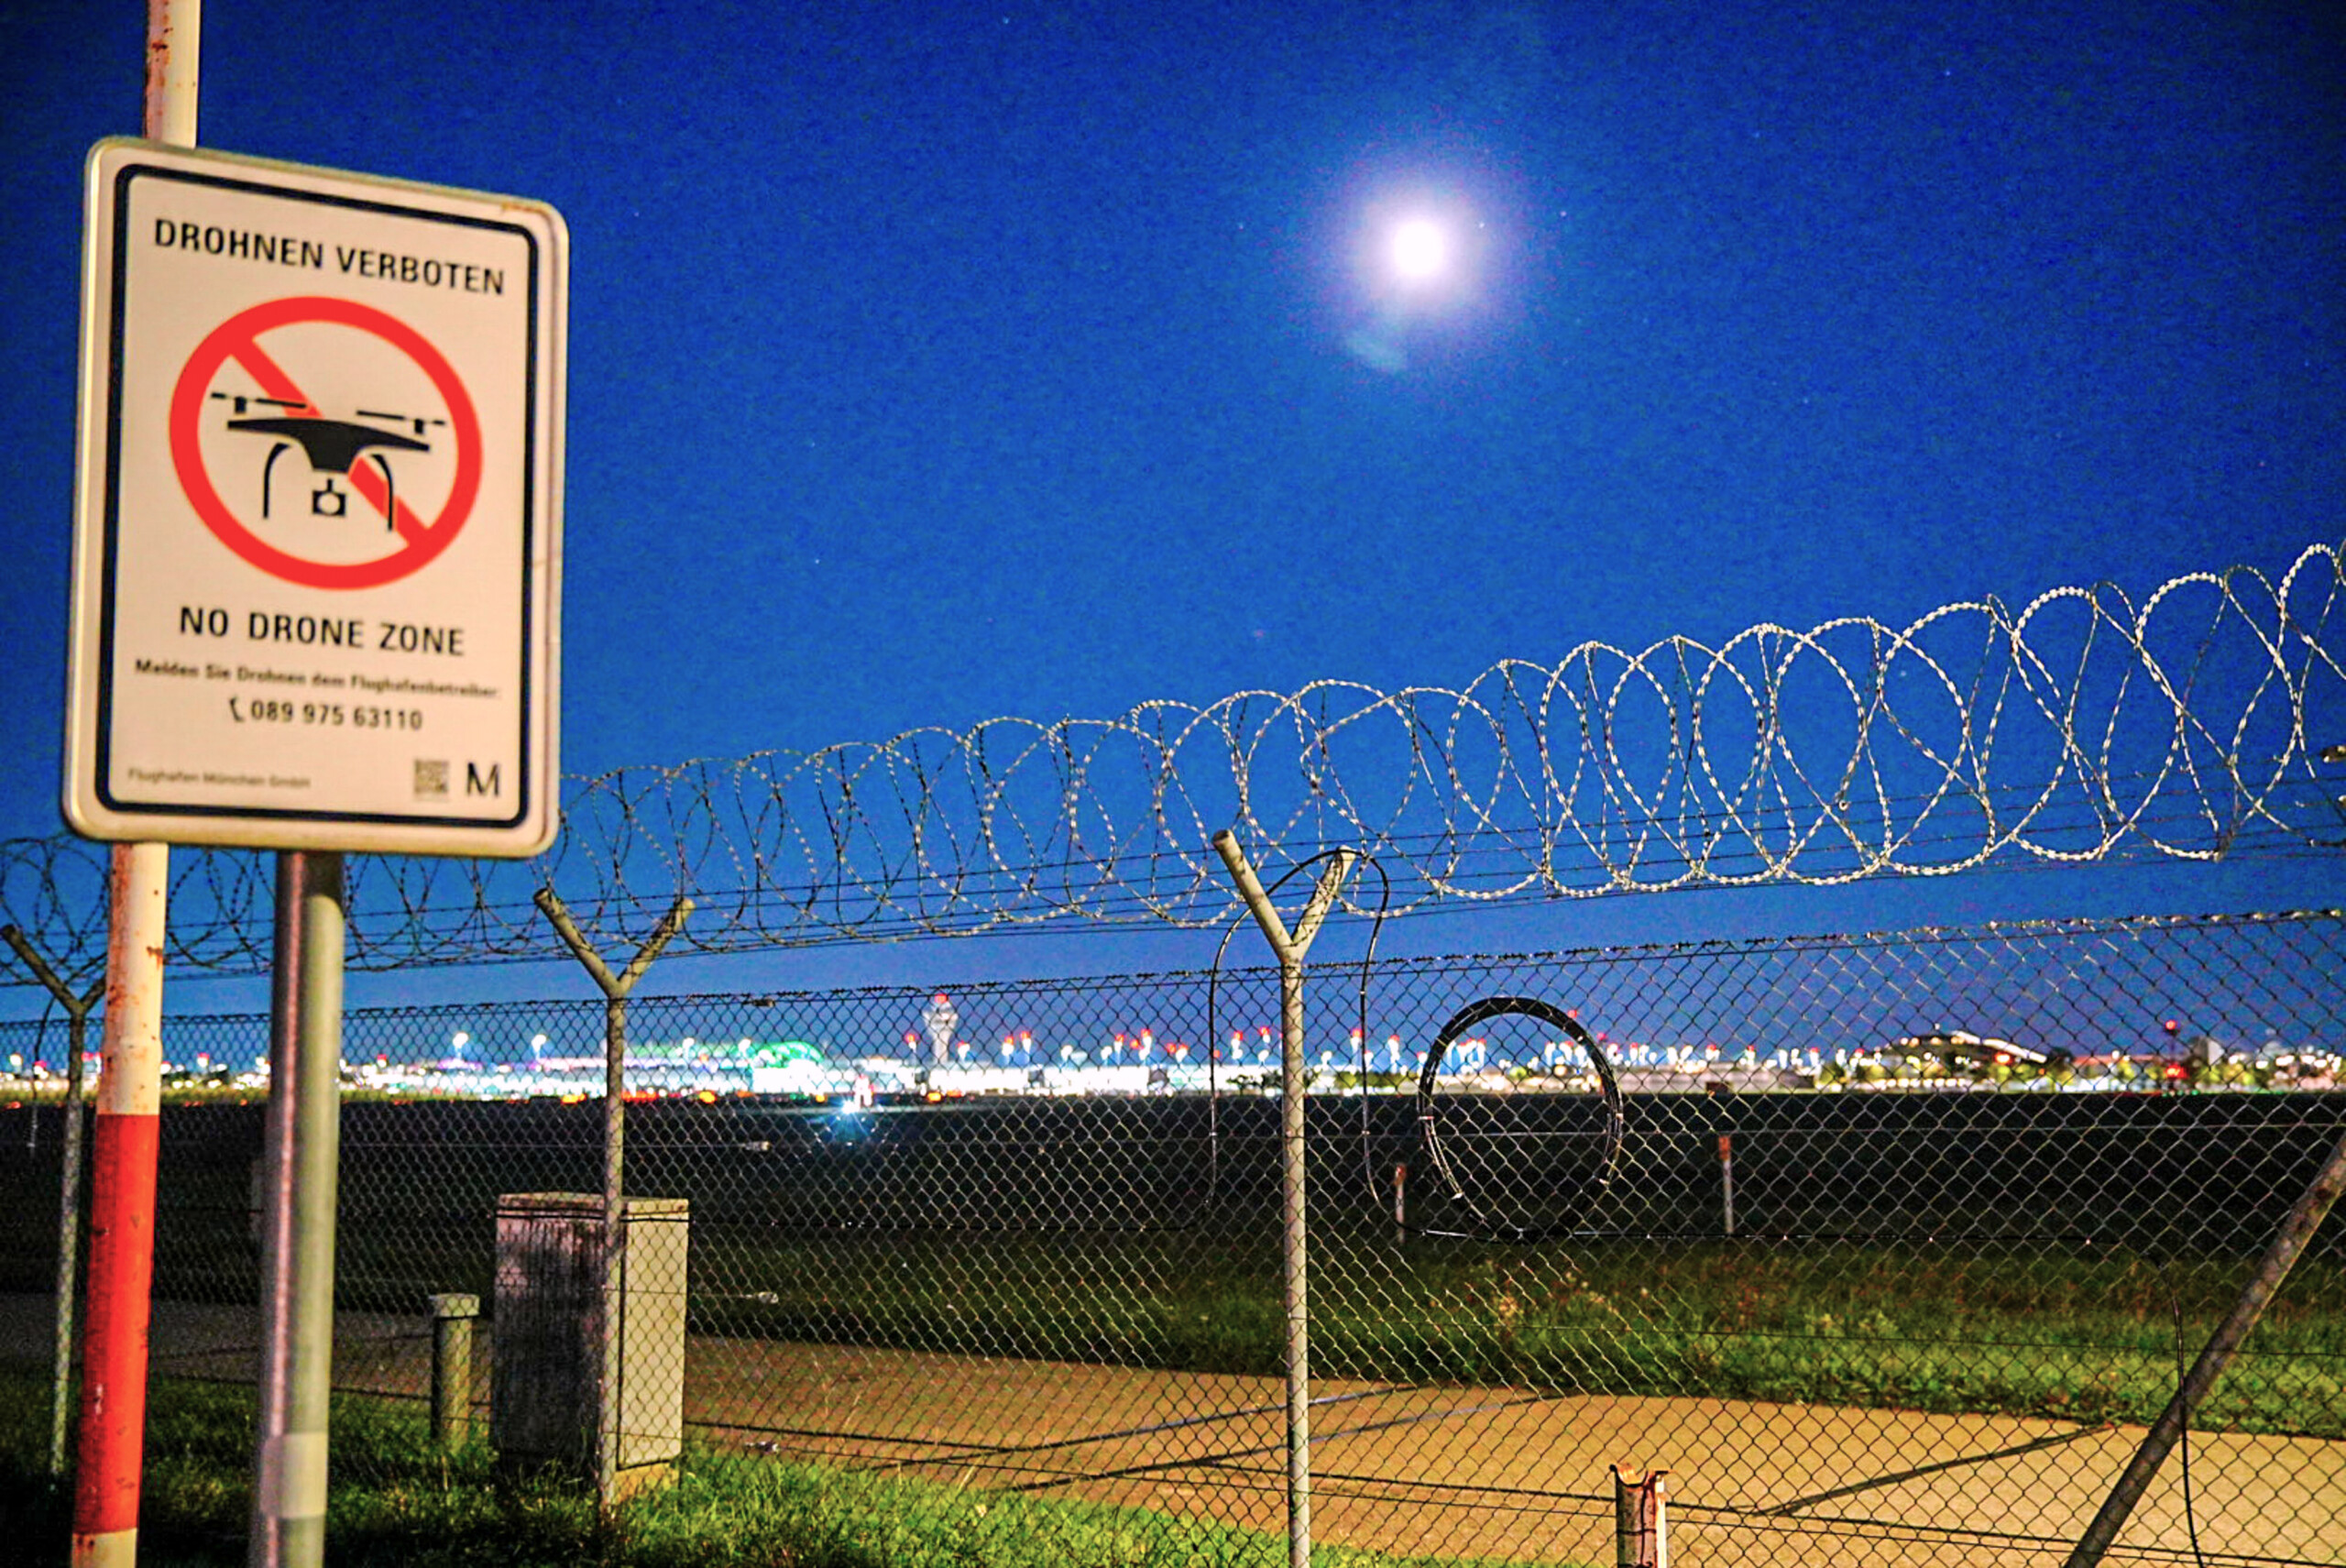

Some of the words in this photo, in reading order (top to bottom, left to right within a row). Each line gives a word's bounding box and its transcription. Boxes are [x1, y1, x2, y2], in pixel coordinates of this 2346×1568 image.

[155, 219, 323, 269] DROHNEN
[336, 247, 505, 296] VERBOTEN
[180, 607, 230, 637] NO
[248, 612, 364, 648] DRONE
[379, 624, 465, 657] ZONE
[136, 659, 199, 677] Melden
[205, 664, 231, 680] Sie
[237, 666, 306, 684] Drohnen
[312, 672, 345, 686] dem
[251, 699, 293, 722] 089
[303, 704, 345, 726] 975
[354, 707, 422, 730] 63110
[467, 762, 499, 796] M
